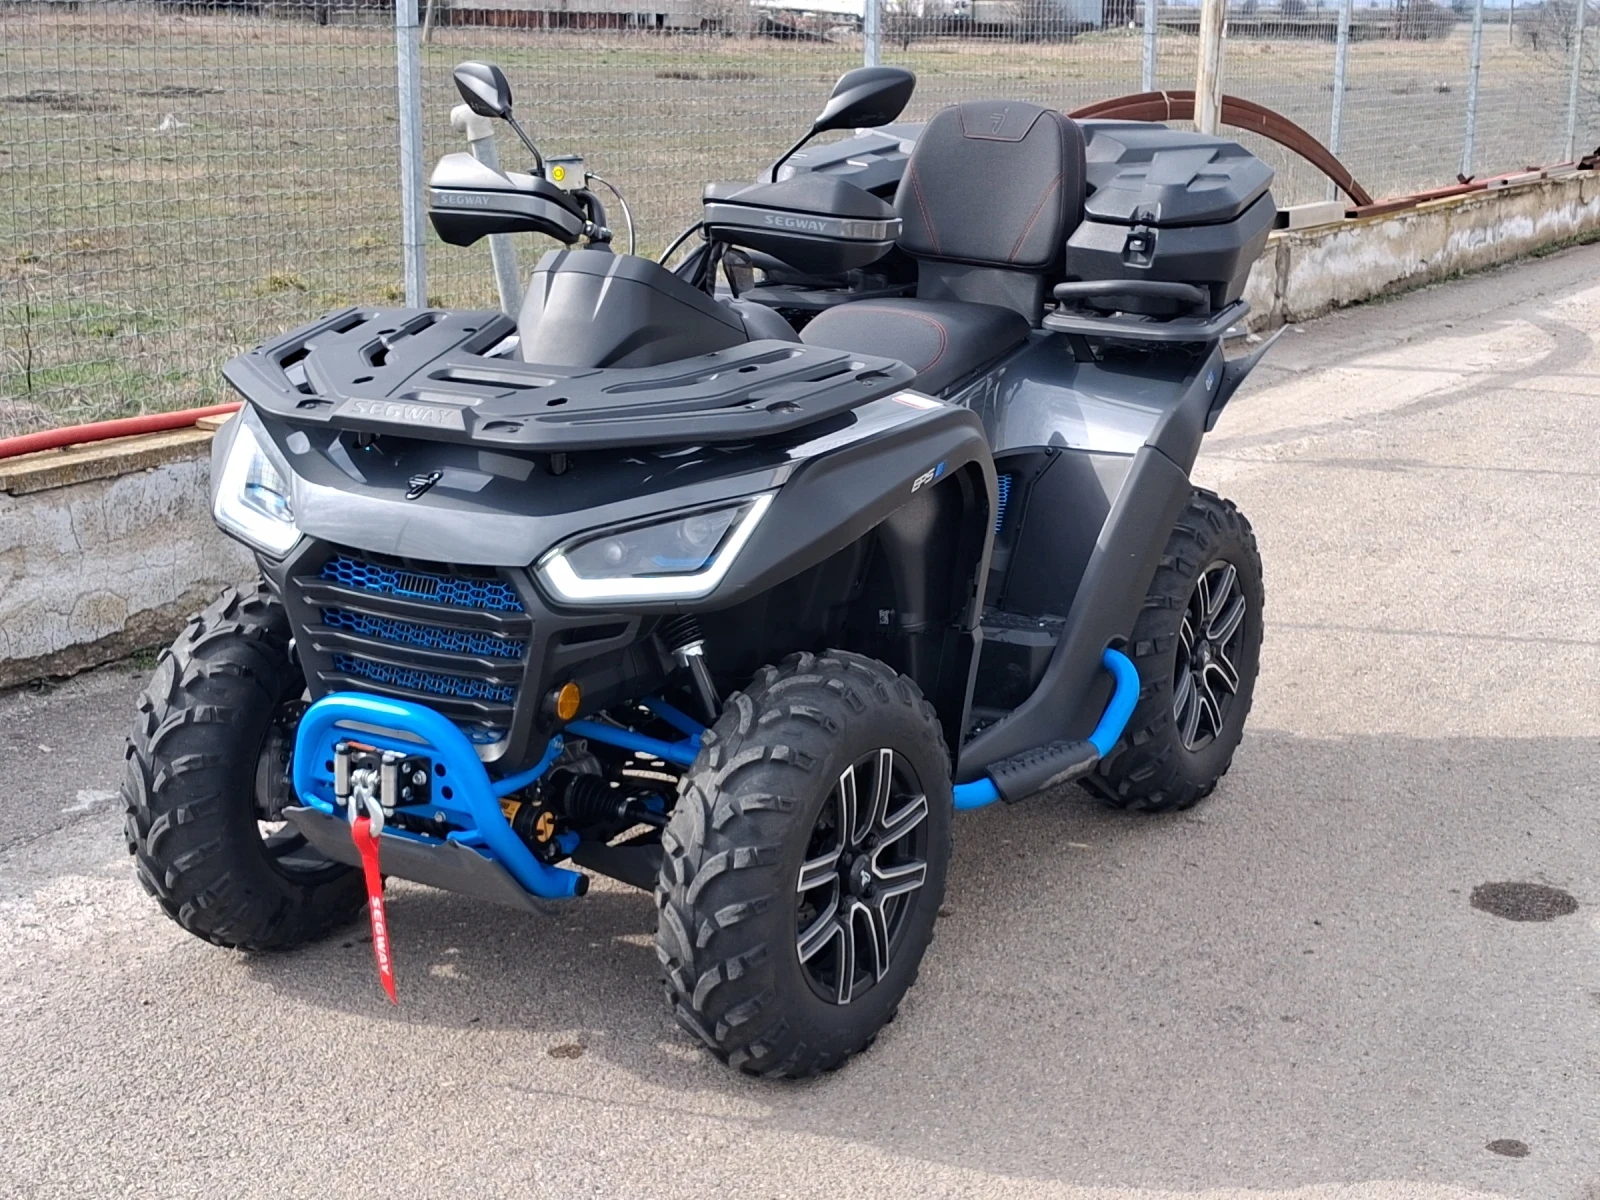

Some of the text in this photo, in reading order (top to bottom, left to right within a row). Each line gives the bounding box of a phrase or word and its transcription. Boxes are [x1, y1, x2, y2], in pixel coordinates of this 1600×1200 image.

[440, 194, 490, 206] SEGWAY
[763, 214, 828, 233] SEGWAY
[351, 400, 454, 424] SEGWAY
[371, 895, 391, 977] SEGWAY
